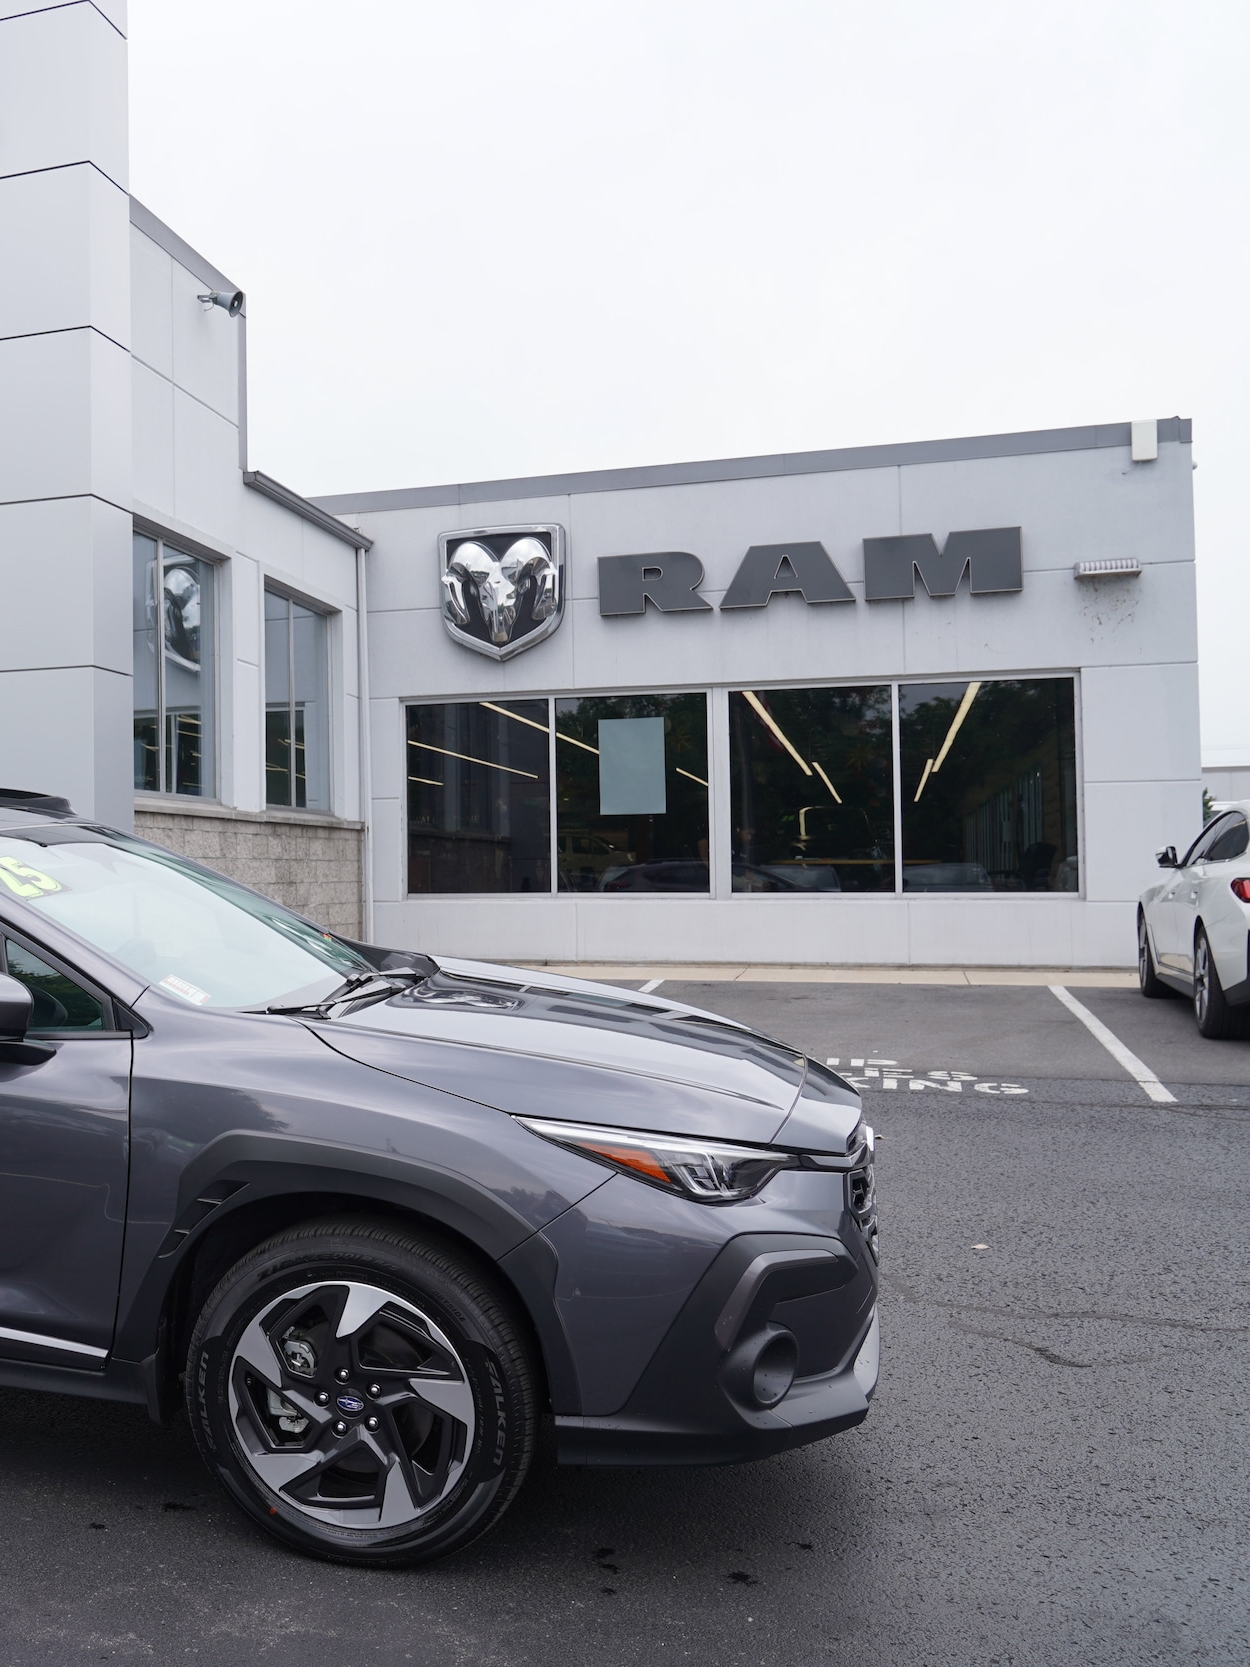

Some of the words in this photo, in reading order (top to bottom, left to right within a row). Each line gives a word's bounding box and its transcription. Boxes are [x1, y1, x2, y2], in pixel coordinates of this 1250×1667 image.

[597, 526, 1023, 617] RAM
[846, 1077, 1029, 1095] KING
[484, 1357, 508, 1467] FALKEN
